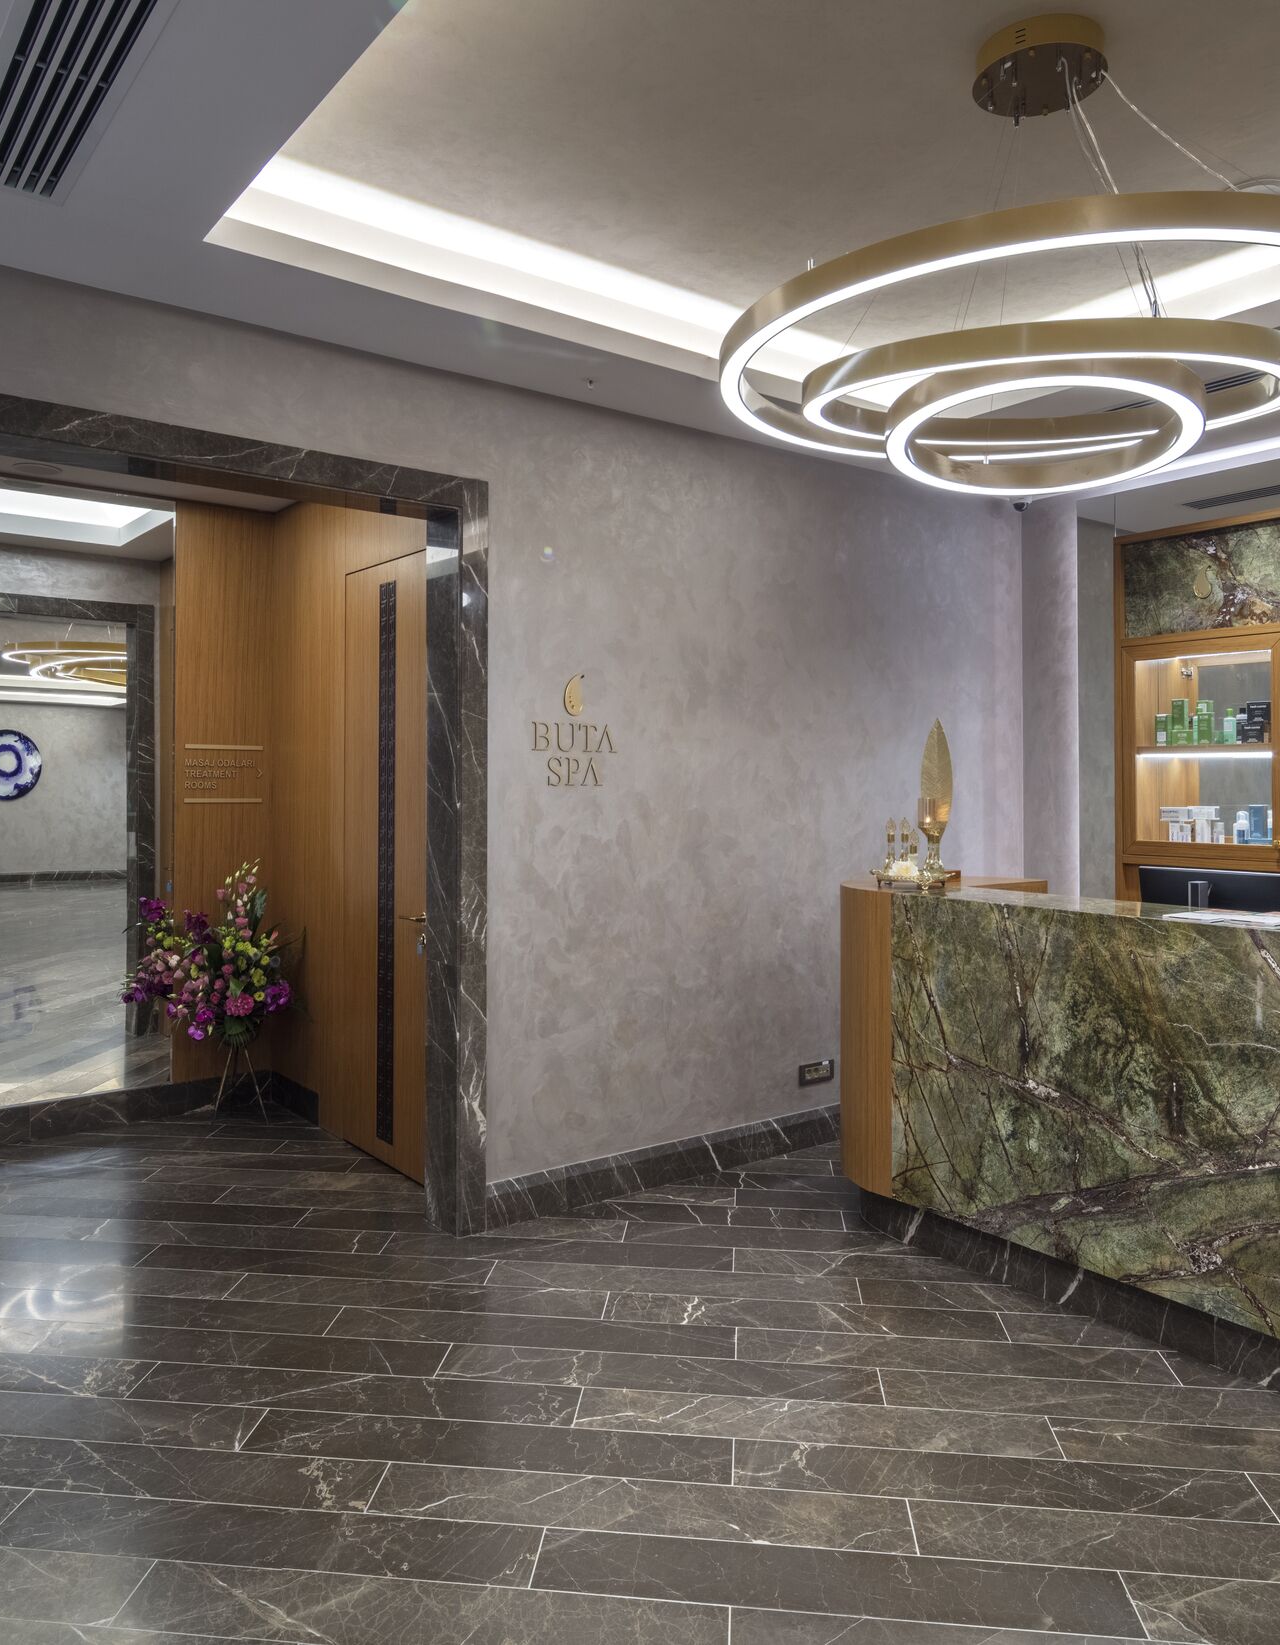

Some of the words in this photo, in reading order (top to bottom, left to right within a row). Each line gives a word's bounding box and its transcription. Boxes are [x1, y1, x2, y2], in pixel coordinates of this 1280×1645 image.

[530, 721, 618, 754] BUTA
[184, 758, 215, 767] MASAJ
[217, 759, 256, 768] ODALARI
[184, 769, 238, 778] TREATMENT
[547, 755, 604, 787] SPA
[184, 781, 217, 789] ROOMS
